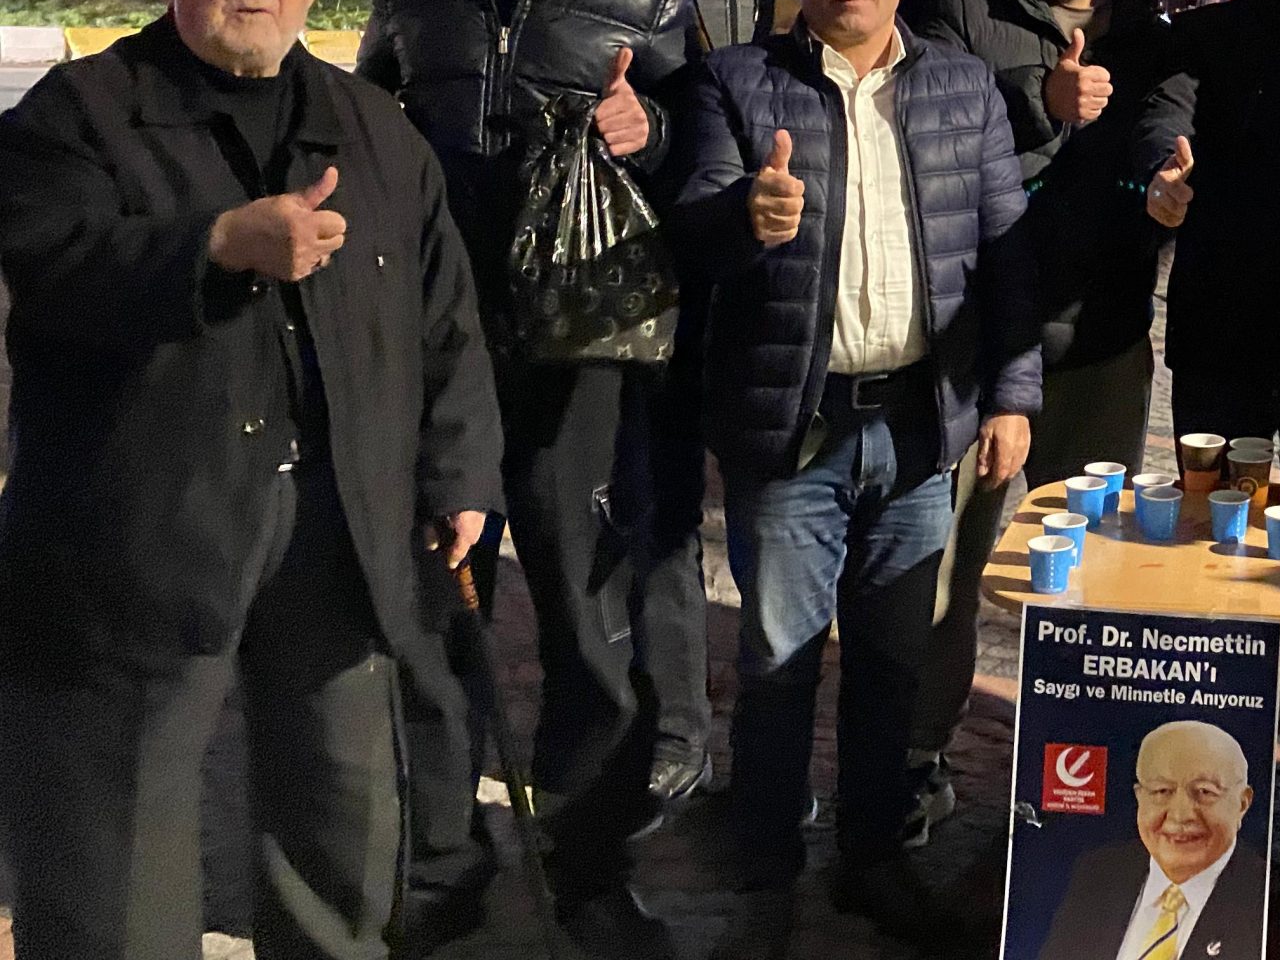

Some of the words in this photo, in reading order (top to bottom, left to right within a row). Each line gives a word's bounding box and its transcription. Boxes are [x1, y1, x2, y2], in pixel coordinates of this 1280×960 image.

[1038, 620, 1092, 645] Prof.
[1102, 625, 1133, 648] Dr.
[1142, 628, 1266, 656] Necmettin
[1033, 678, 1080, 700] Saygı
[1086, 685, 1106, 699] ve
[1111, 684, 1186, 705] Minnetle
[1190, 689, 1264, 709] Anıyoruz
